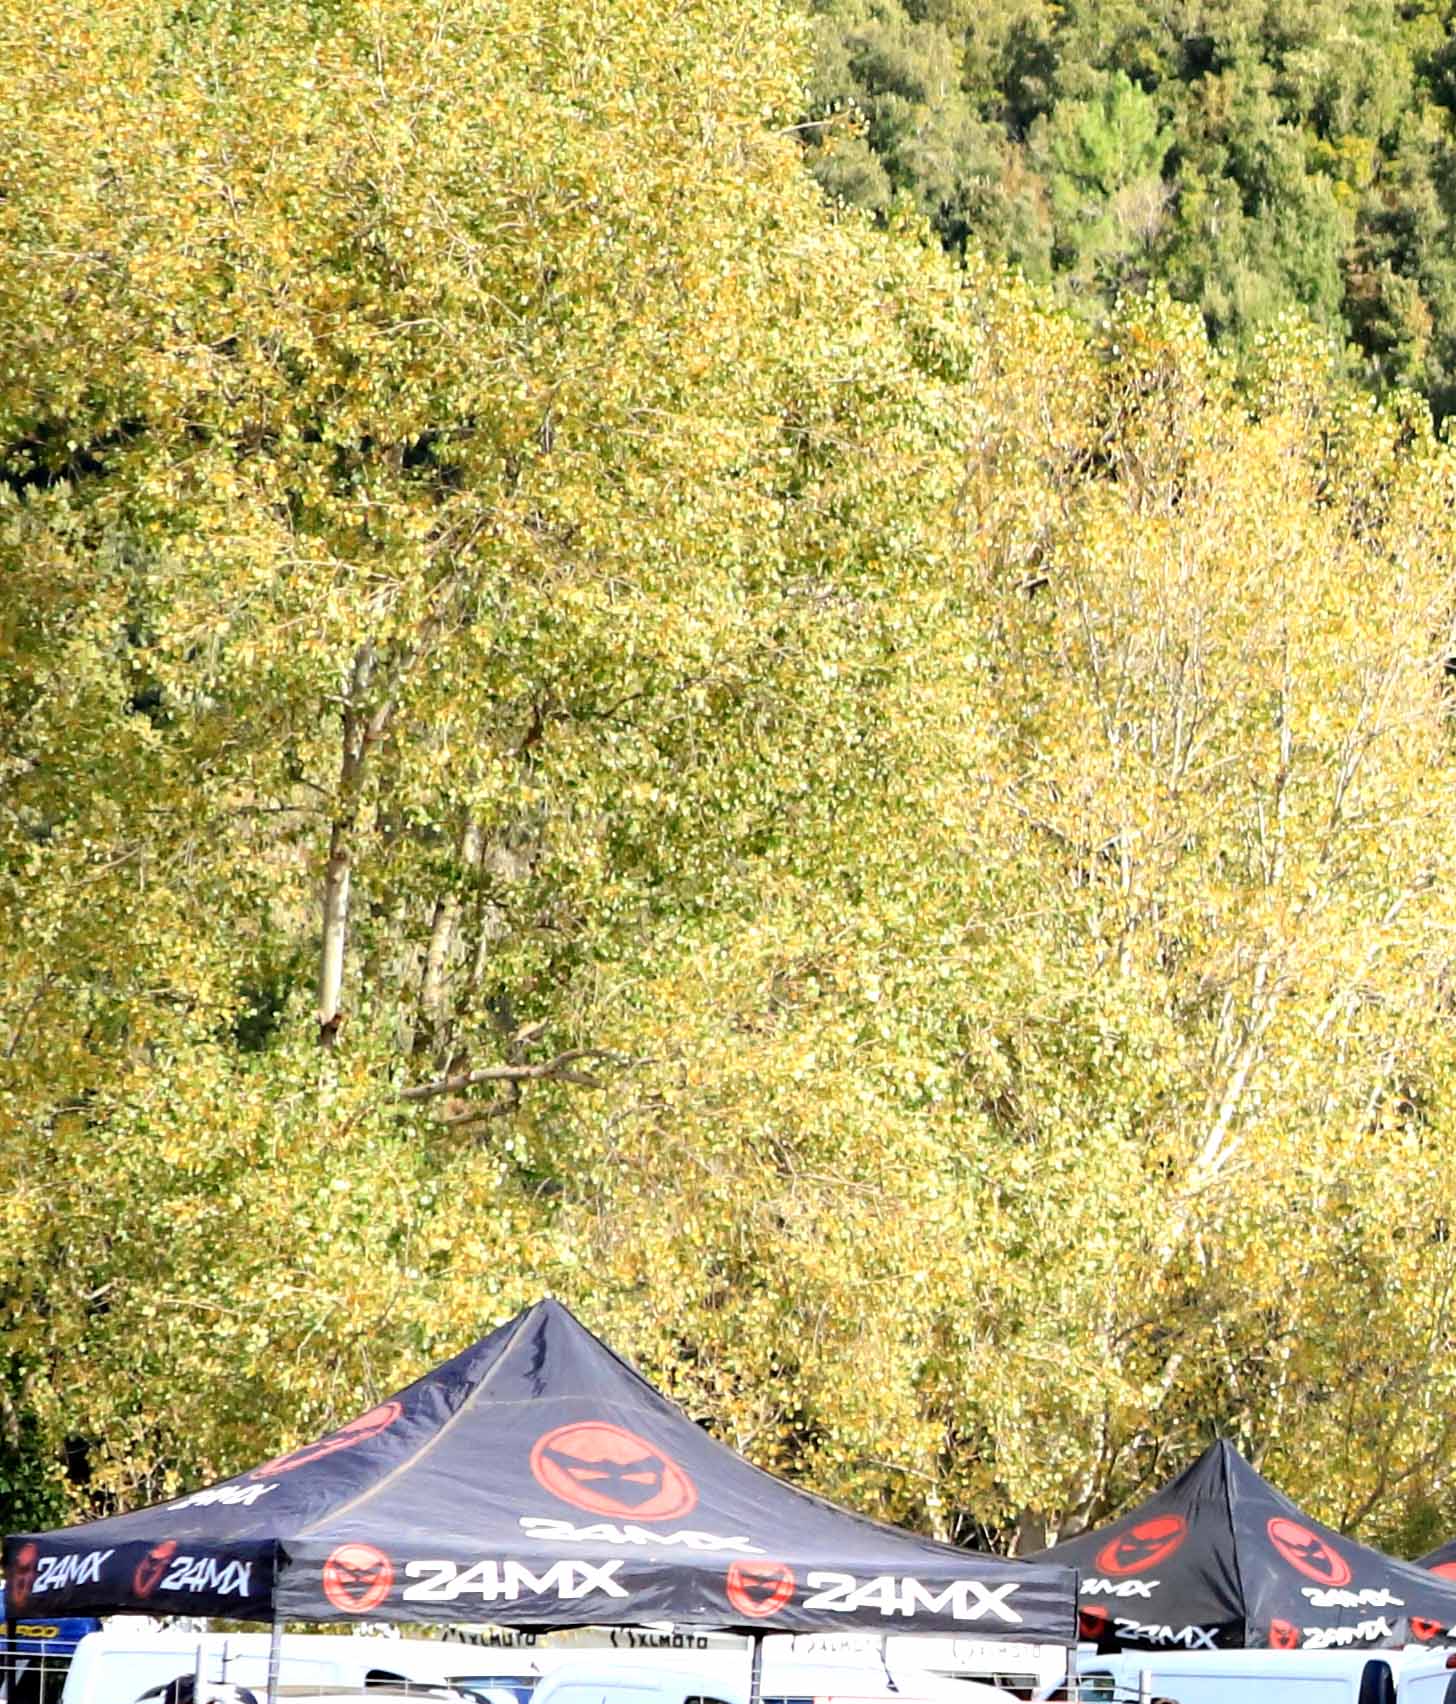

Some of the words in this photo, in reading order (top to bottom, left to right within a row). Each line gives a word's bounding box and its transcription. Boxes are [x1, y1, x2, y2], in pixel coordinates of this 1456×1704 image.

[519, 1517, 767, 1554] 24MX
[32, 1549, 115, 1594] 24MX
[160, 1556, 252, 1598] 24MX
[402, 1558, 630, 1602] 24MX
[803, 1572, 1023, 1622] 24MX
[638, 1630, 708, 1650] XLMOTO
[1113, 1617, 1219, 1650] 24MX
